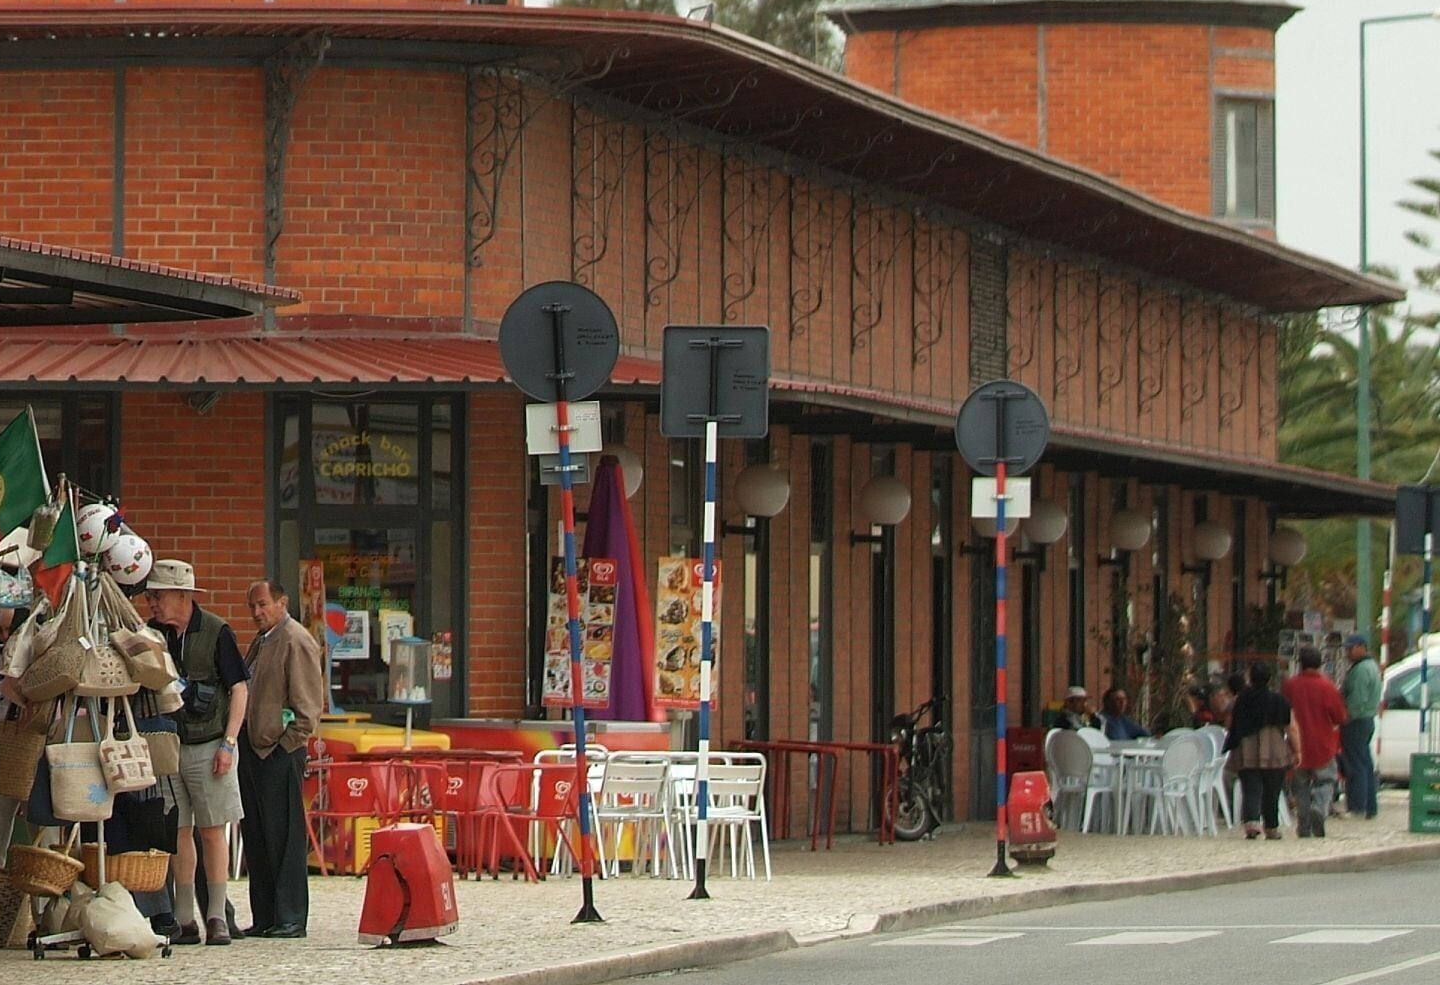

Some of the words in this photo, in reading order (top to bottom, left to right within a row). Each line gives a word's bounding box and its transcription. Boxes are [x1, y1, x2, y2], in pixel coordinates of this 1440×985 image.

[320, 431, 372, 463] snack
[380, 436, 409, 462] bar
[320, 462, 410, 477] CAPRICHO
